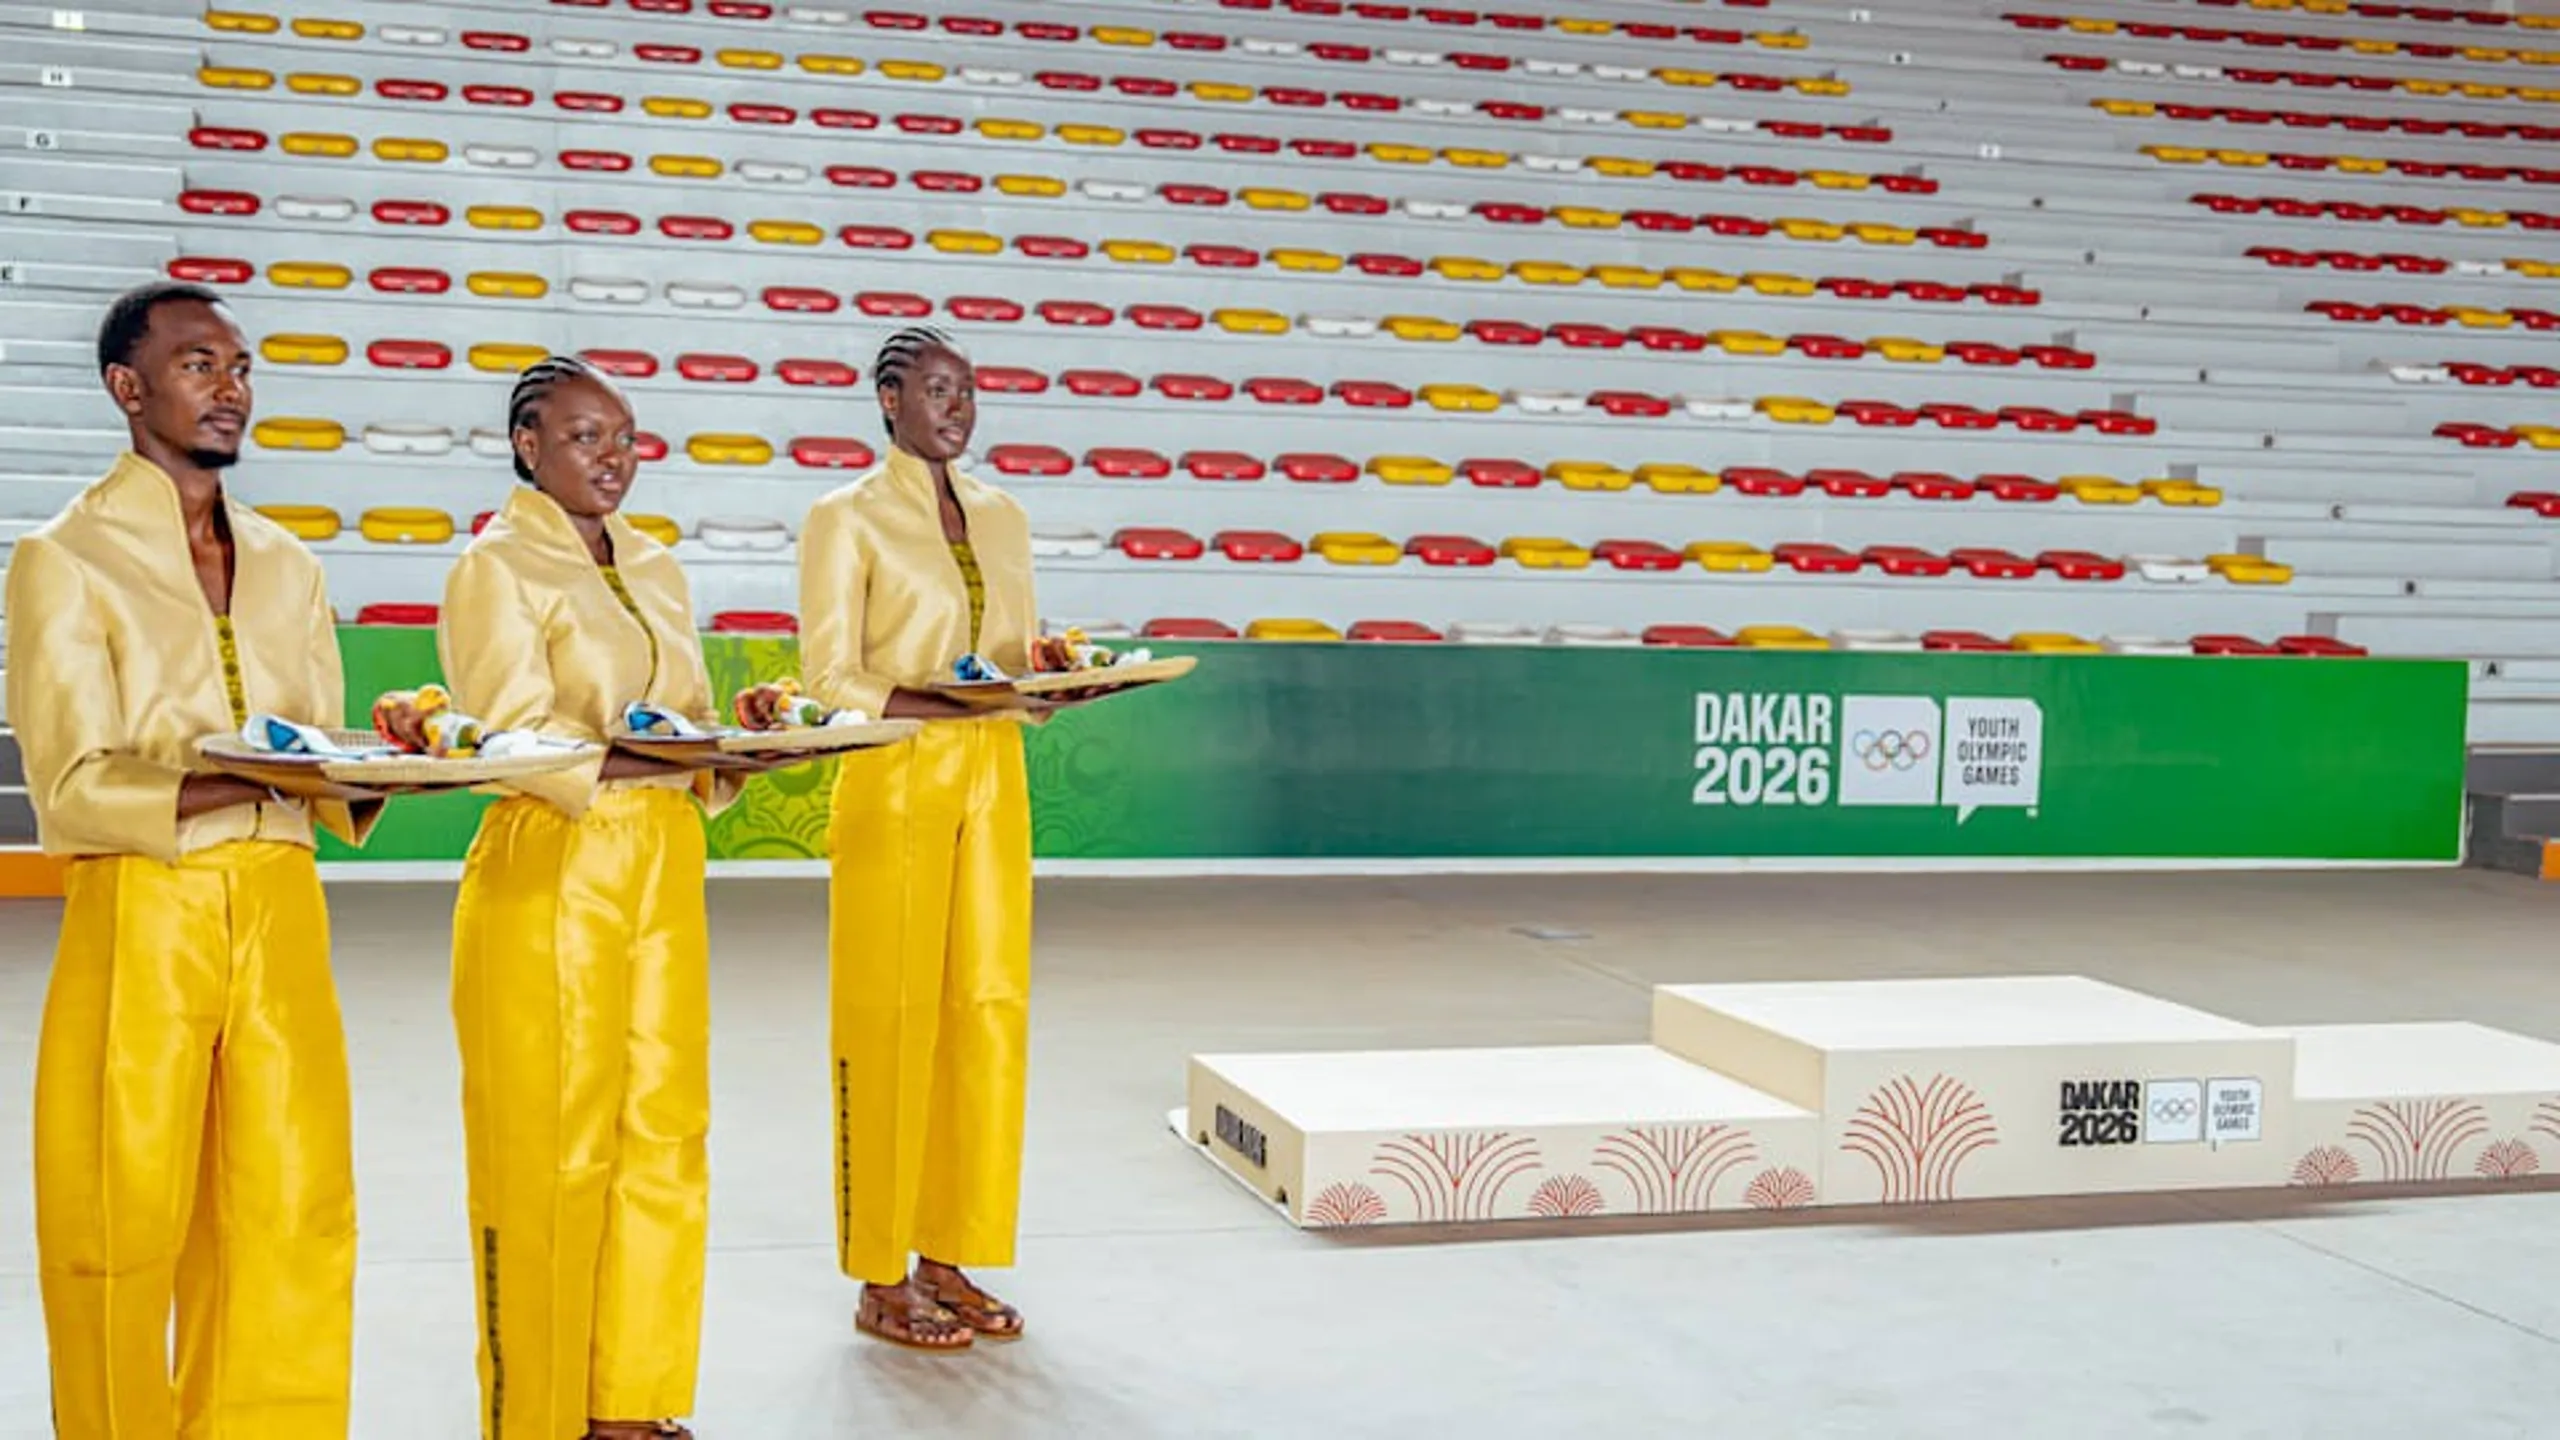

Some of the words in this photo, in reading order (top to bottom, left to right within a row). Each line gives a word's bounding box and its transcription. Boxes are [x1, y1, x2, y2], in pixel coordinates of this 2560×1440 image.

[1694, 692, 1833, 745] DAKAR
[1967, 717, 2020, 739] YOUTH
[1957, 741, 2028, 763] OLYMPIC
[1693, 747, 1831, 805] 2026
[1962, 765, 2019, 786] GAMES
[2060, 1080, 2140, 1111] DAKAR
[2059, 1112, 2138, 1146] 2026
